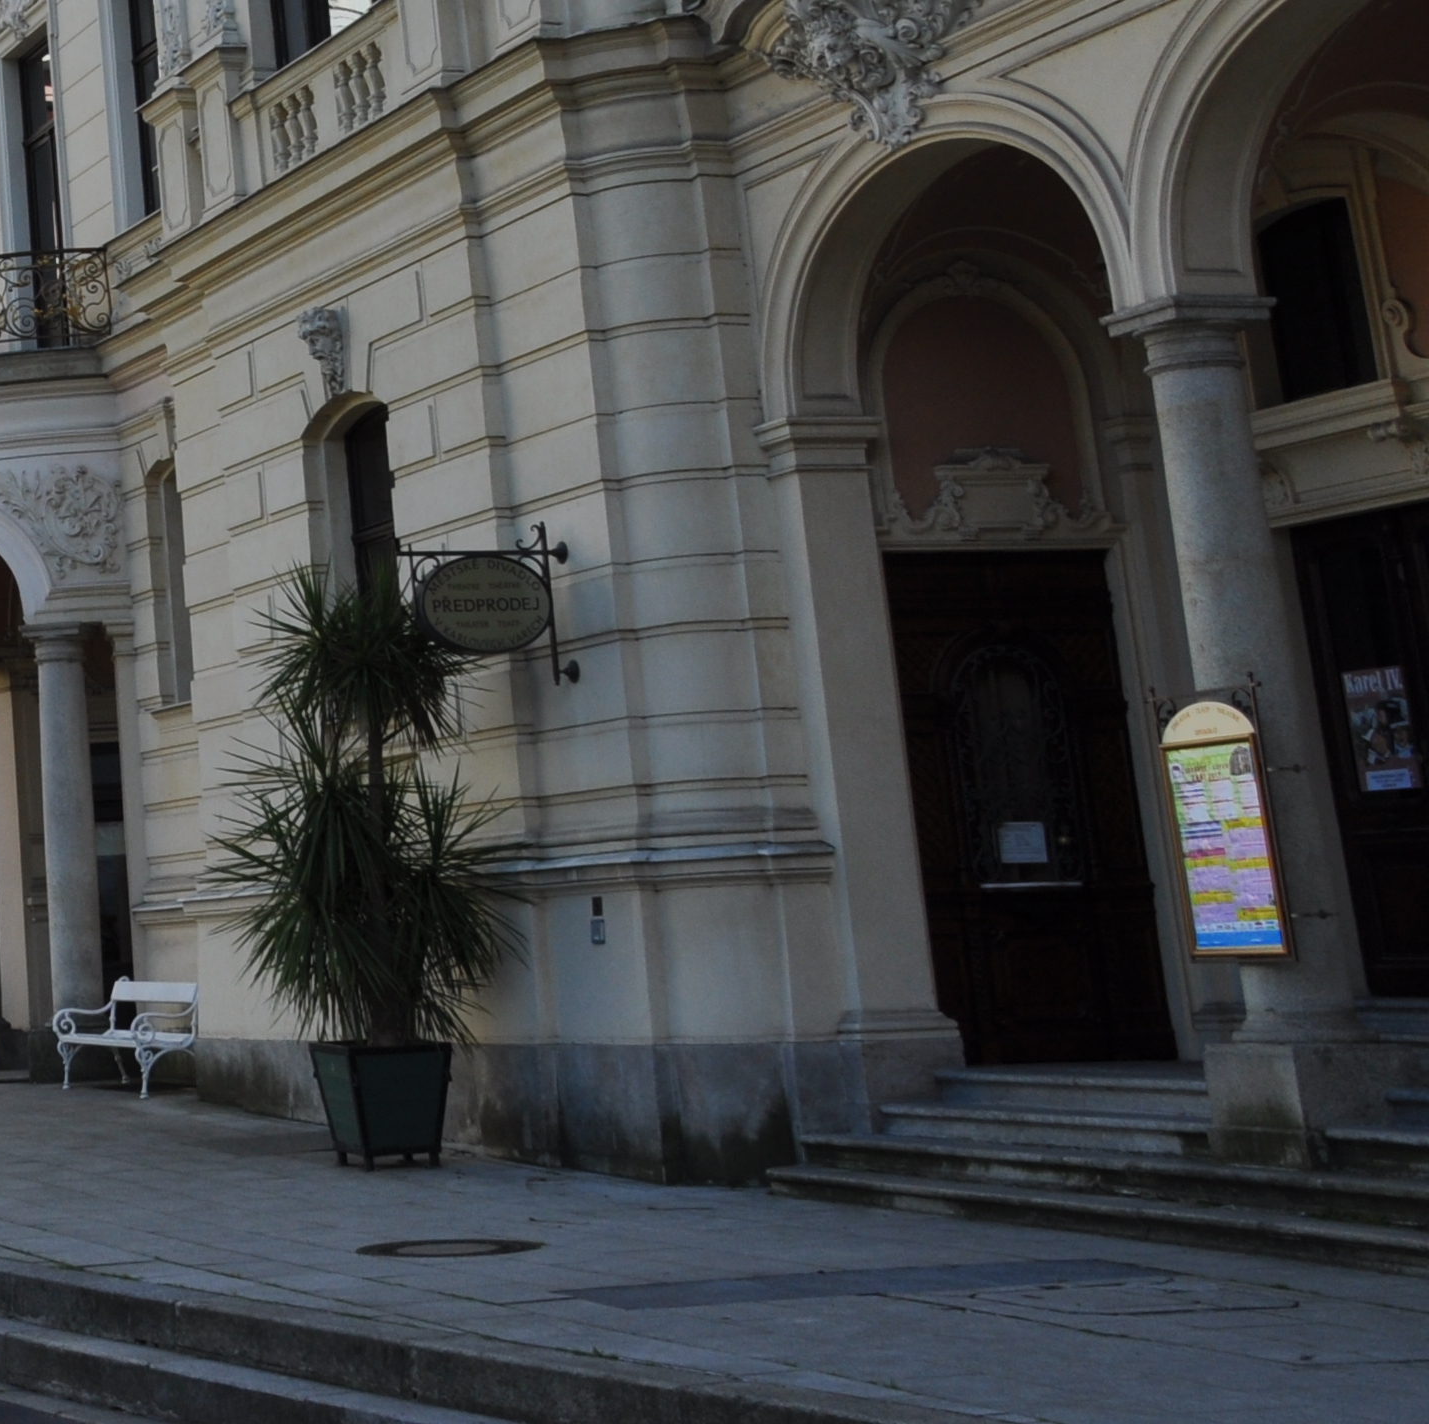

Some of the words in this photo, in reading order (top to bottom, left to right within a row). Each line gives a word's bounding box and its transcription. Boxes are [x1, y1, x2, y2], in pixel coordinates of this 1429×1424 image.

[487, 559, 541, 591] DIVADLO
[431, 596, 540, 613] PŘEDPRODEJ
[1343, 670, 1381, 694] Karel
[1384, 668, 1403, 690] IV.
